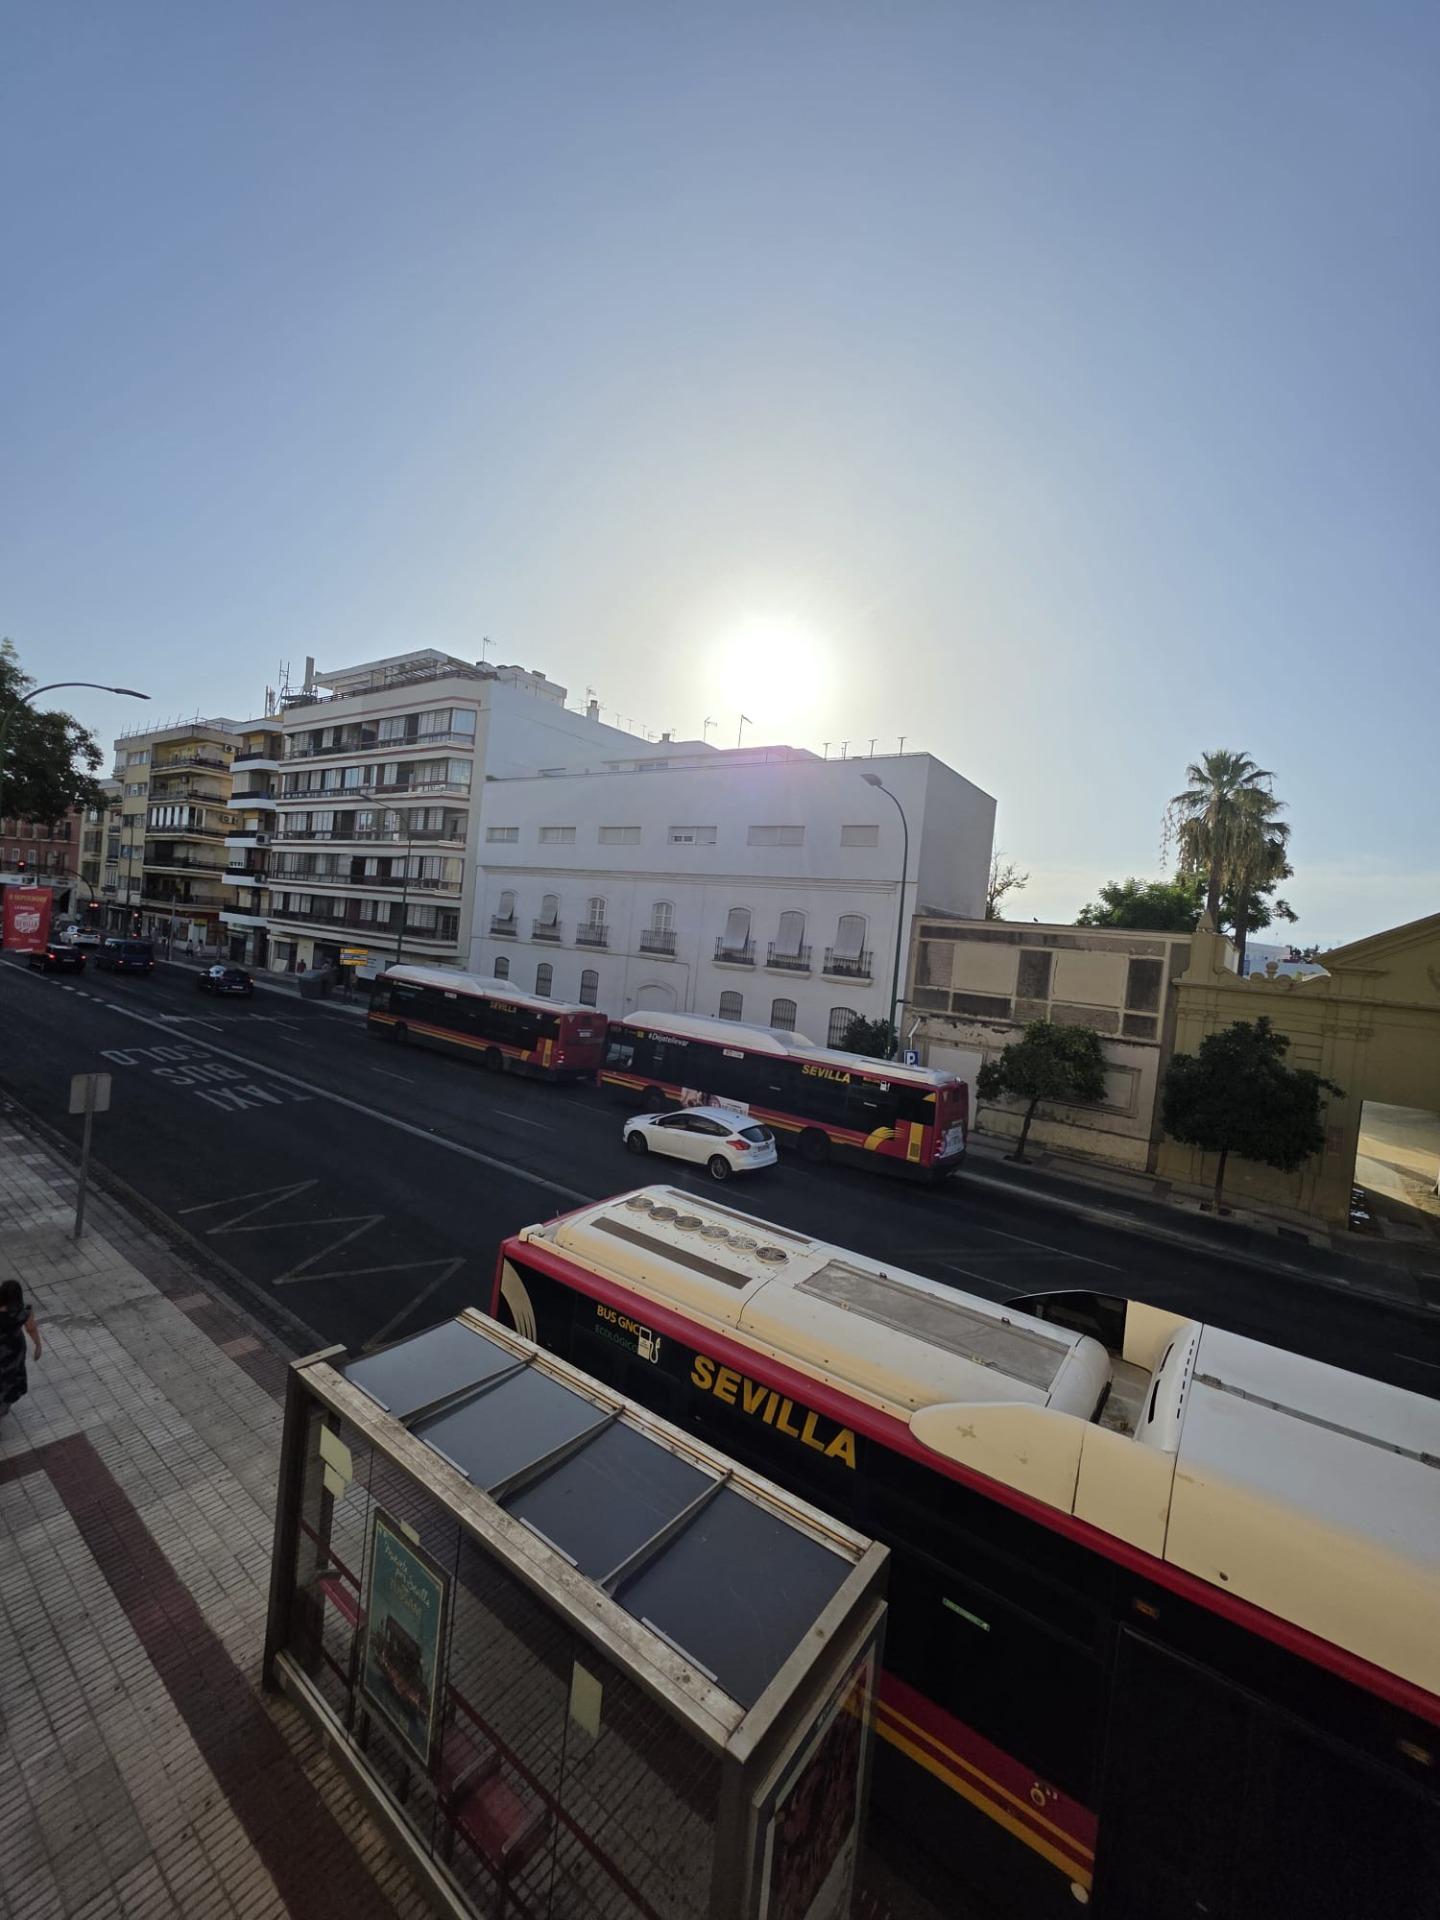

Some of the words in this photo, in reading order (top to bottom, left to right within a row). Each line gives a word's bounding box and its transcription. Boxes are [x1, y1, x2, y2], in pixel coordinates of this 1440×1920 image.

[489, 1000, 518, 1014] SEVILLA
[100, 1044, 213, 1066] SOLO
[152, 1062, 249, 1085] BUS
[801, 1063, 851, 1084] SEVILLA
[193, 1081, 314, 1112] TAXI
[596, 1303, 617, 1323] BUS
[618, 1316, 640, 1336] GNC
[689, 1354, 857, 1470] SEVILLA
